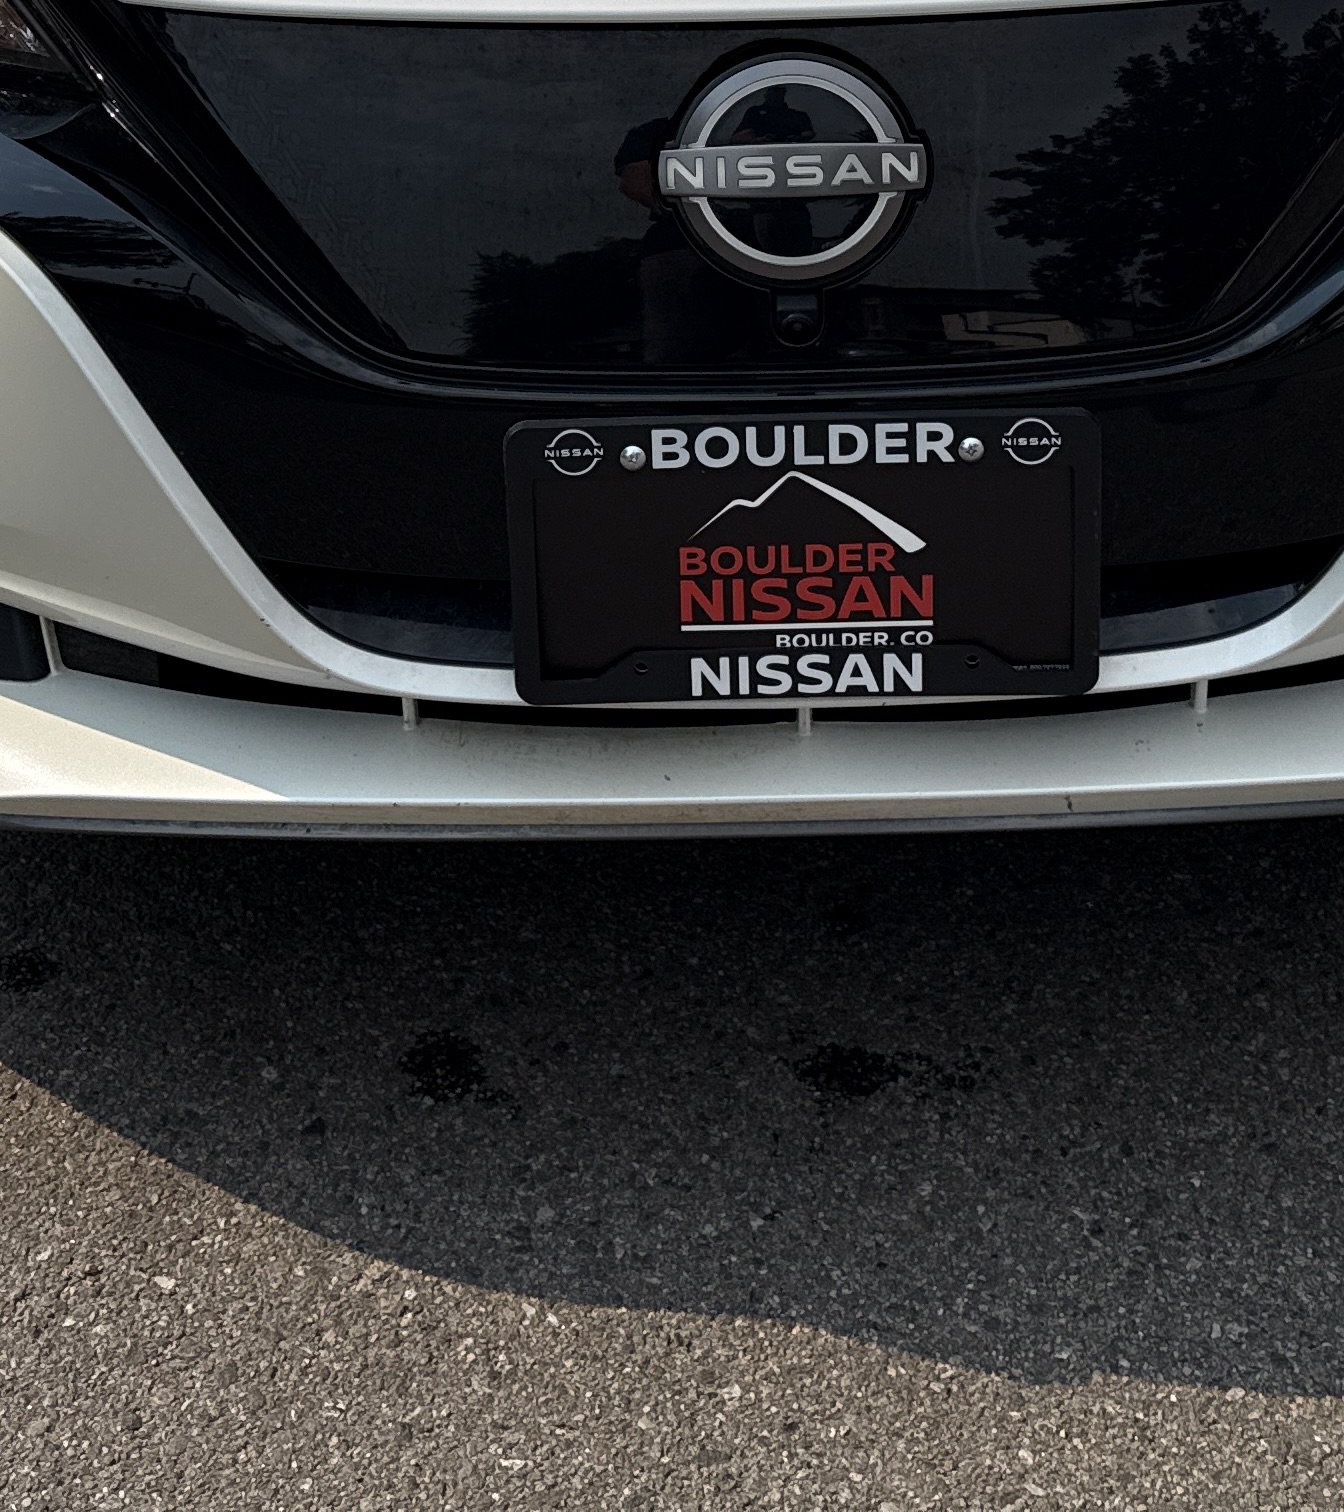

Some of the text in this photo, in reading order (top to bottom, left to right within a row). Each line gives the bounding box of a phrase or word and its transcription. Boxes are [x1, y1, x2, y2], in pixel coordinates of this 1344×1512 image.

[666, 151, 919, 190] NISSAN
[544, 447, 604, 458] NISSAN
[651, 422, 956, 470] BOULDER
[1001, 436, 1062, 446] NISSAN
[679, 542, 896, 576] BOULDER
[680, 574, 934, 622] NISSAN
[900, 630, 934, 647] CO
[690, 652, 923, 696] NISSAN
